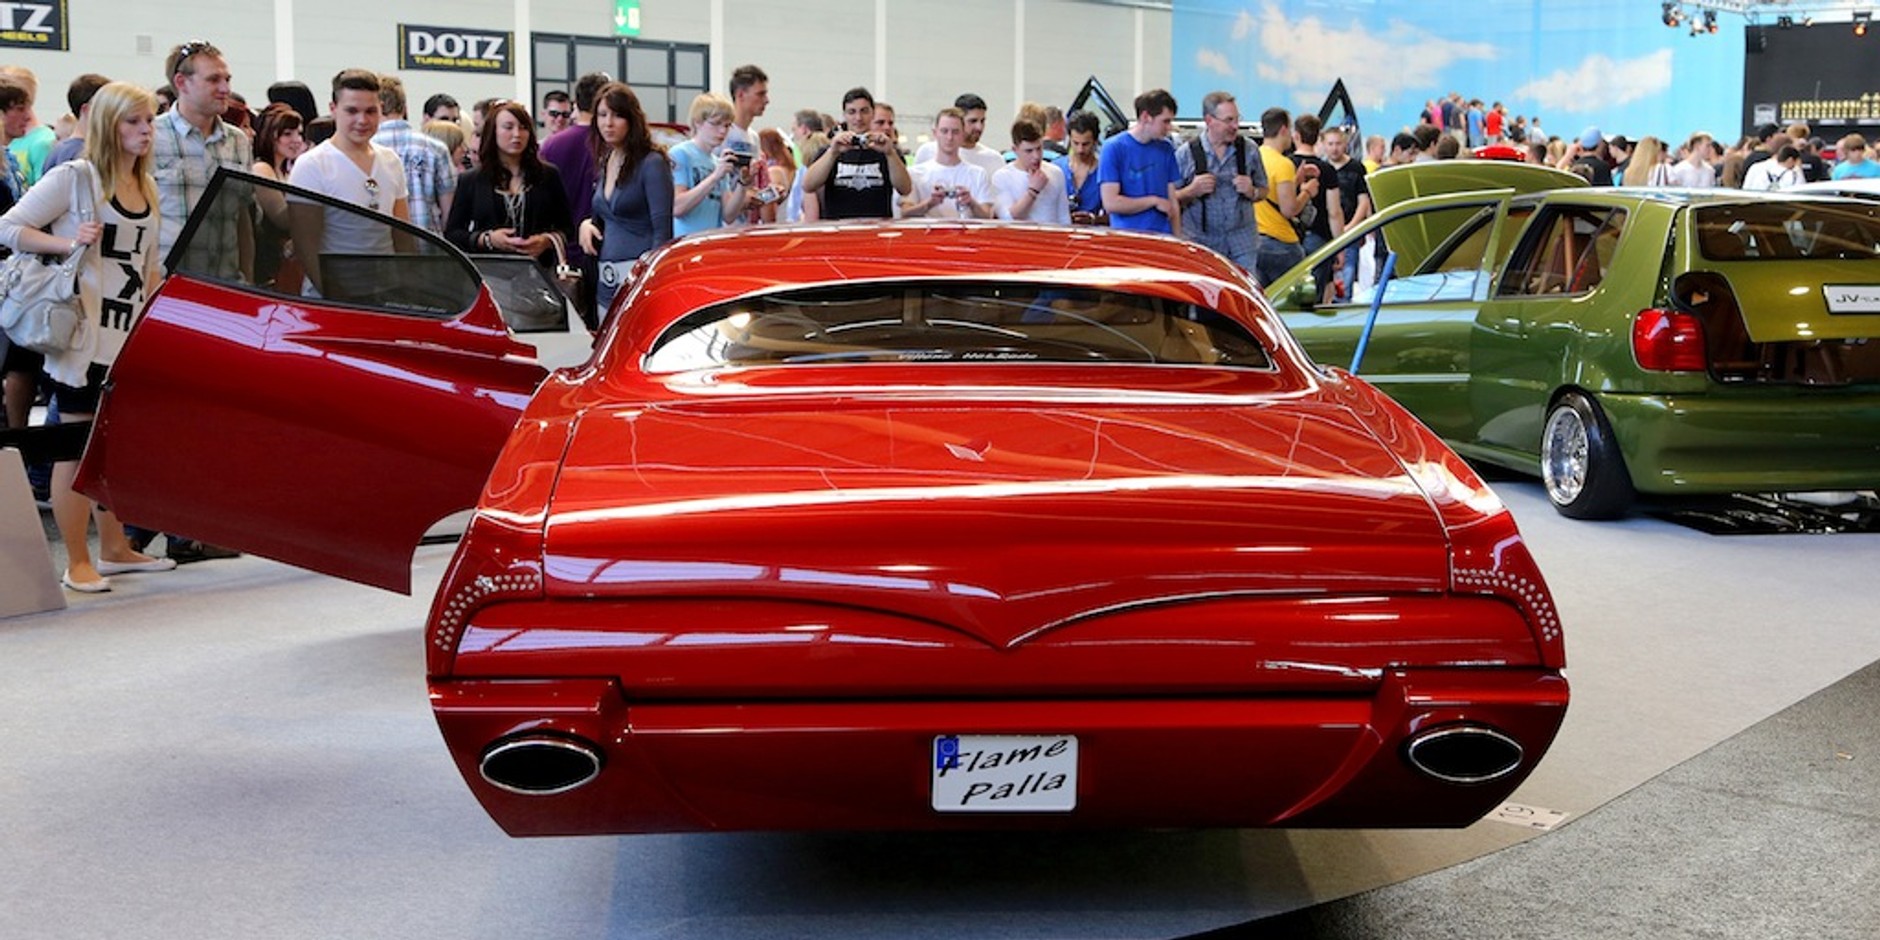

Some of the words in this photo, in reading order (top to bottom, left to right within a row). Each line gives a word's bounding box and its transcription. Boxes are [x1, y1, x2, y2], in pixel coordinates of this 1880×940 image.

[409, 31, 505, 60] DOTZ
[939, 739, 1068, 777] Flame
[960, 771, 1067, 805] Palla
